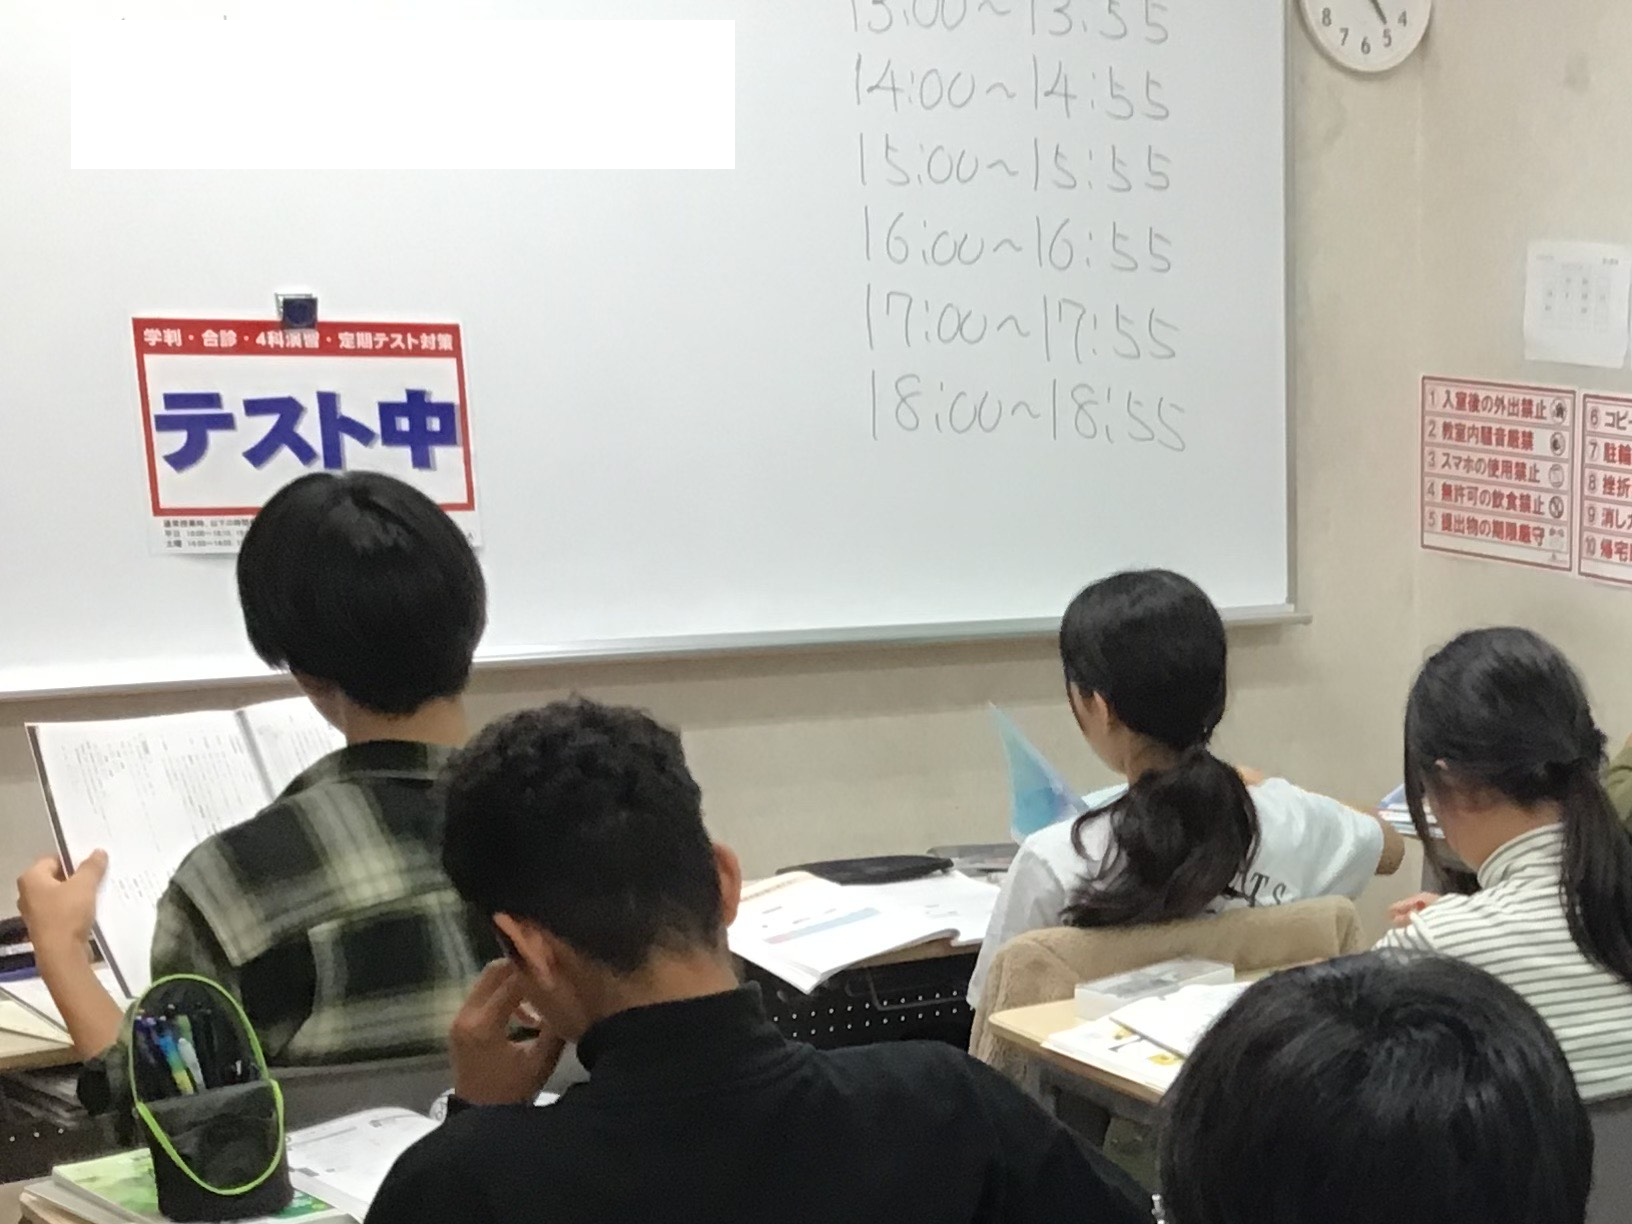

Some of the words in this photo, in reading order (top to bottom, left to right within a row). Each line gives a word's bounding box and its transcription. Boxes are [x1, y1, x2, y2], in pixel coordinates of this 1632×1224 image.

[1322, 7, 1332, 27] 8
[1398, 10, 1407, 27] 4
[1340, 27, 1349, 46] 7
[1361, 36, 1371, 55] 6
[1383, 28, 1392, 48] 5
[1442, 390, 1548, 421] 入室後の外出禁止
[154, 389, 459, 472] テスト中
[1441, 453, 1541, 484] スマホの使用禁止
[1441, 482, 1546, 515] 無許可の飲食禁止
